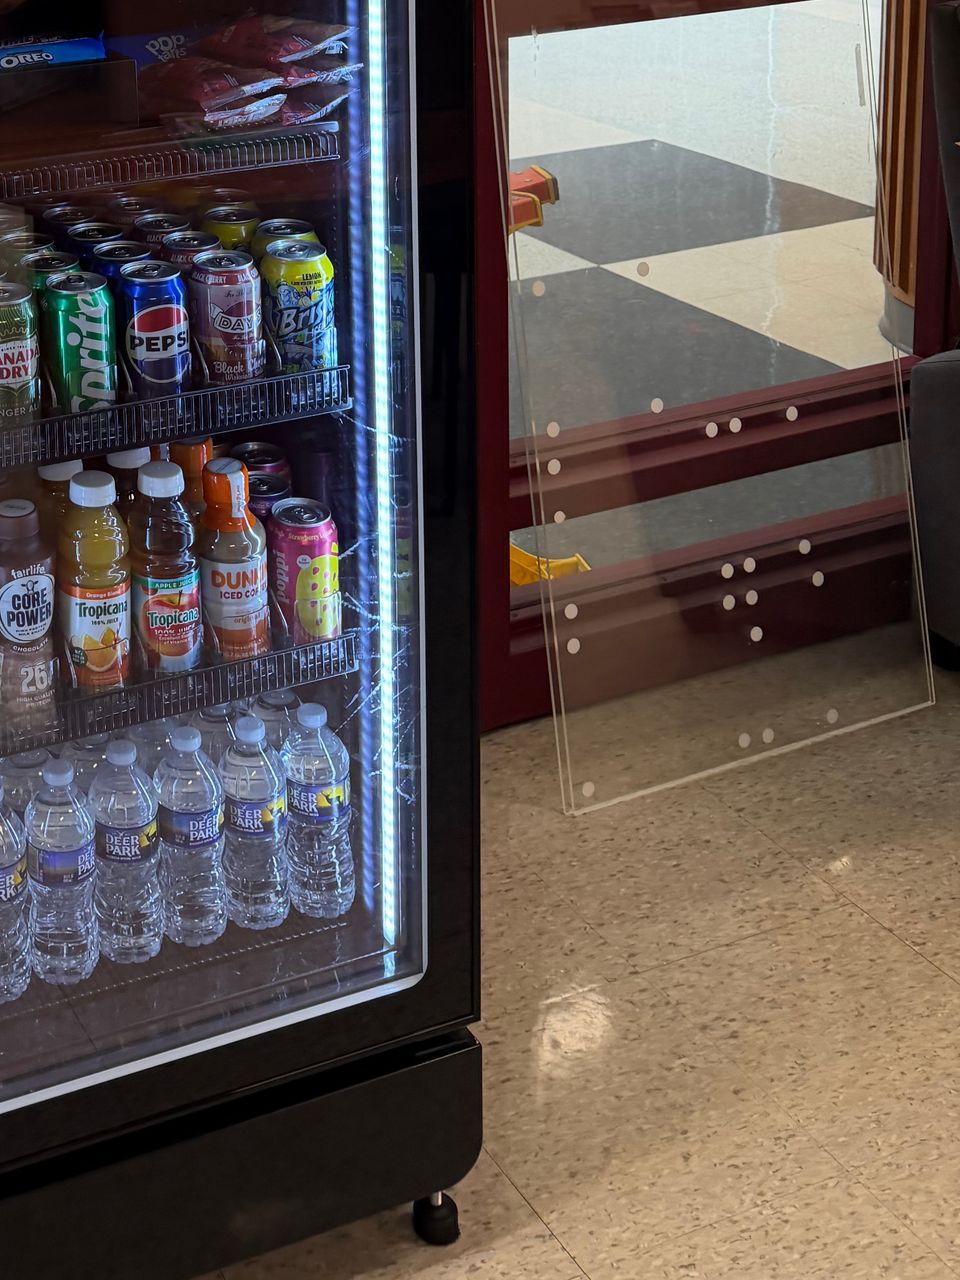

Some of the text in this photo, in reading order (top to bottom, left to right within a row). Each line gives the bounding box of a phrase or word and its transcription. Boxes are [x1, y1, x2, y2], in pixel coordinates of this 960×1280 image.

[0, 51, 53, 69] OREO
[302, 272, 322, 281] LEMON
[0, 364, 30, 380] DRY
[213, 361, 245, 374] Black
[273, 549, 290, 604] poppi
[11, 587, 47, 611] CORE
[86, 591, 107, 599] Orange
[220, 591, 242, 599] ICED
[6, 601, 52, 628] POWER
[75, 600, 128, 619] Tropicana
[147, 607, 199, 628] Tropicana
[12, 638, 49, 652] CHOCOLATE
[287, 785, 318, 803] DEER
[229, 804, 262, 819] DEER
[288, 796, 318, 813] PARK
[189, 815, 219, 831] DEER
[230, 814, 263, 830] PARK
[105, 833, 139, 846] DEER
[190, 825, 220, 841] PARK
[105, 843, 141, 857] PARK
